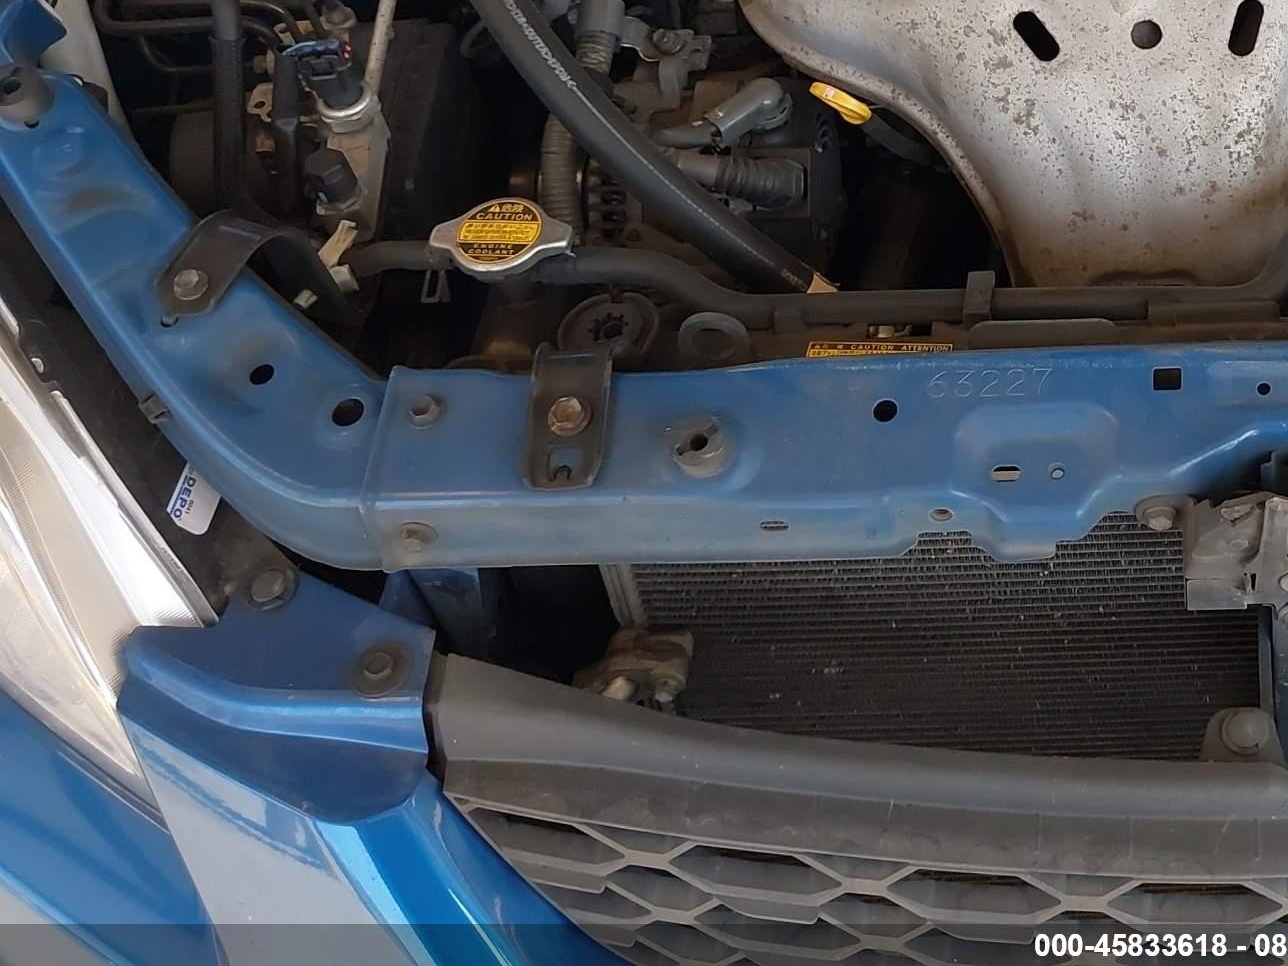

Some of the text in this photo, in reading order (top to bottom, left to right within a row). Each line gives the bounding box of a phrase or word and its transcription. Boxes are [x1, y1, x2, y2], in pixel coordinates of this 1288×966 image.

[476, 213, 533, 221] CAUTION
[901, 344, 949, 352] ATTENTION
[927, 368, 1053, 399] 63227
[173, 476, 197, 519] DEPO
